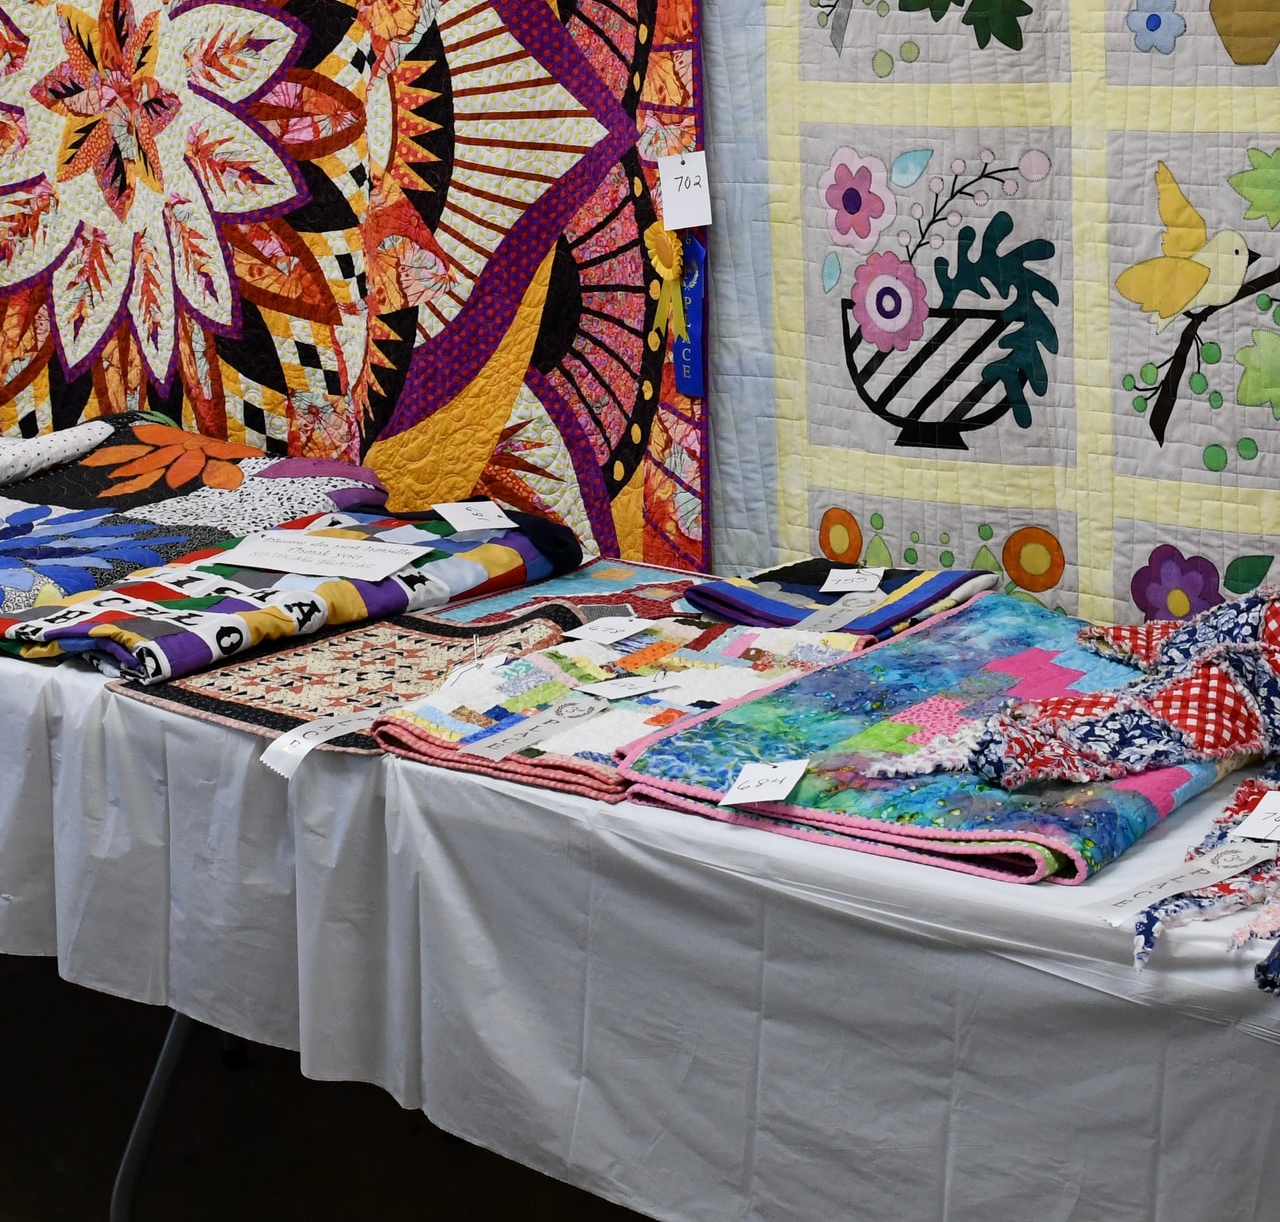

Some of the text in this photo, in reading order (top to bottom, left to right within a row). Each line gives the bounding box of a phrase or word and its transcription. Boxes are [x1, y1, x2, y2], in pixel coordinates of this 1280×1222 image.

[674, 175, 702, 192] 702
[283, 717, 374, 754] PLACE
[486, 719, 560, 750] PLACE
[737, 776, 787, 791] 684
[1112, 868, 1211, 908] PLACE
